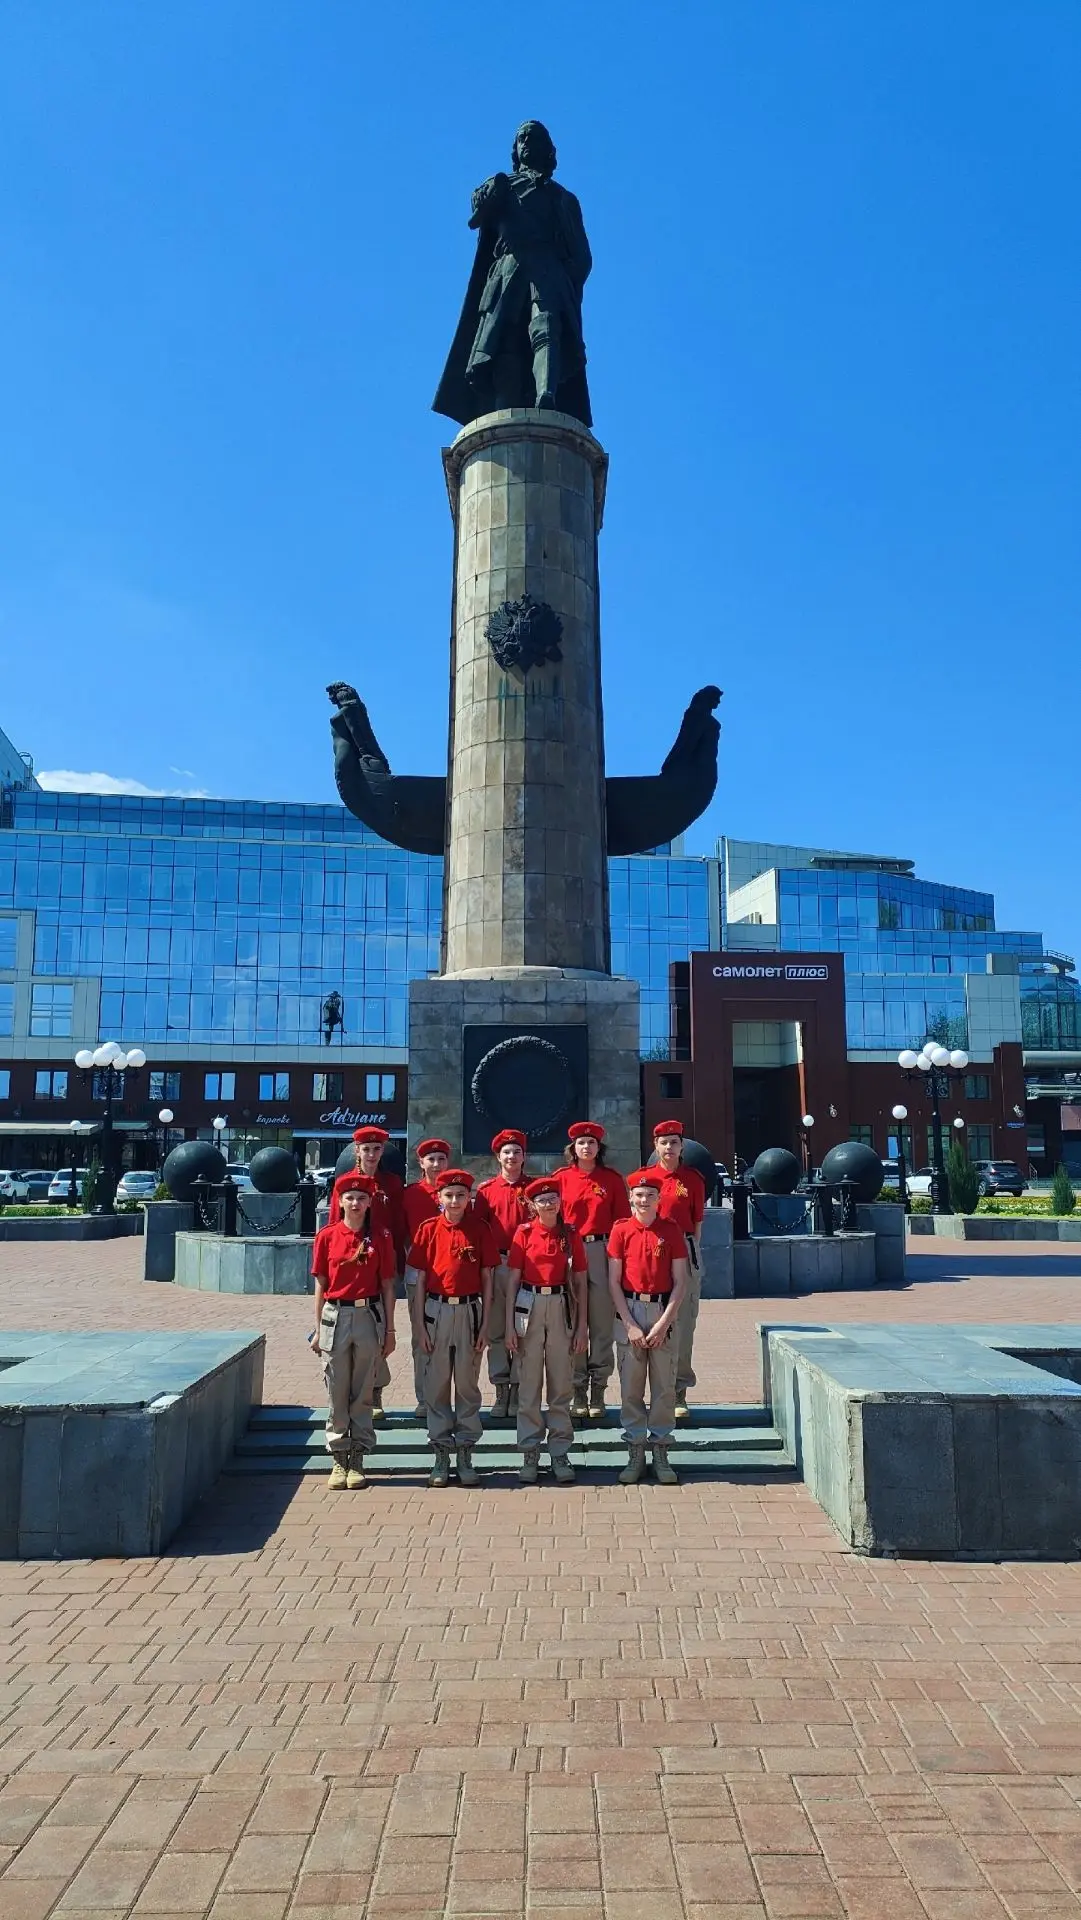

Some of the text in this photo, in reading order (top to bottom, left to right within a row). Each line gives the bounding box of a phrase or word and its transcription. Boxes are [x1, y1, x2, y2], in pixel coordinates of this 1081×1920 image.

[712, 966, 826, 977] самолет плюс
[319, 1106, 387, 1127] Adriano
